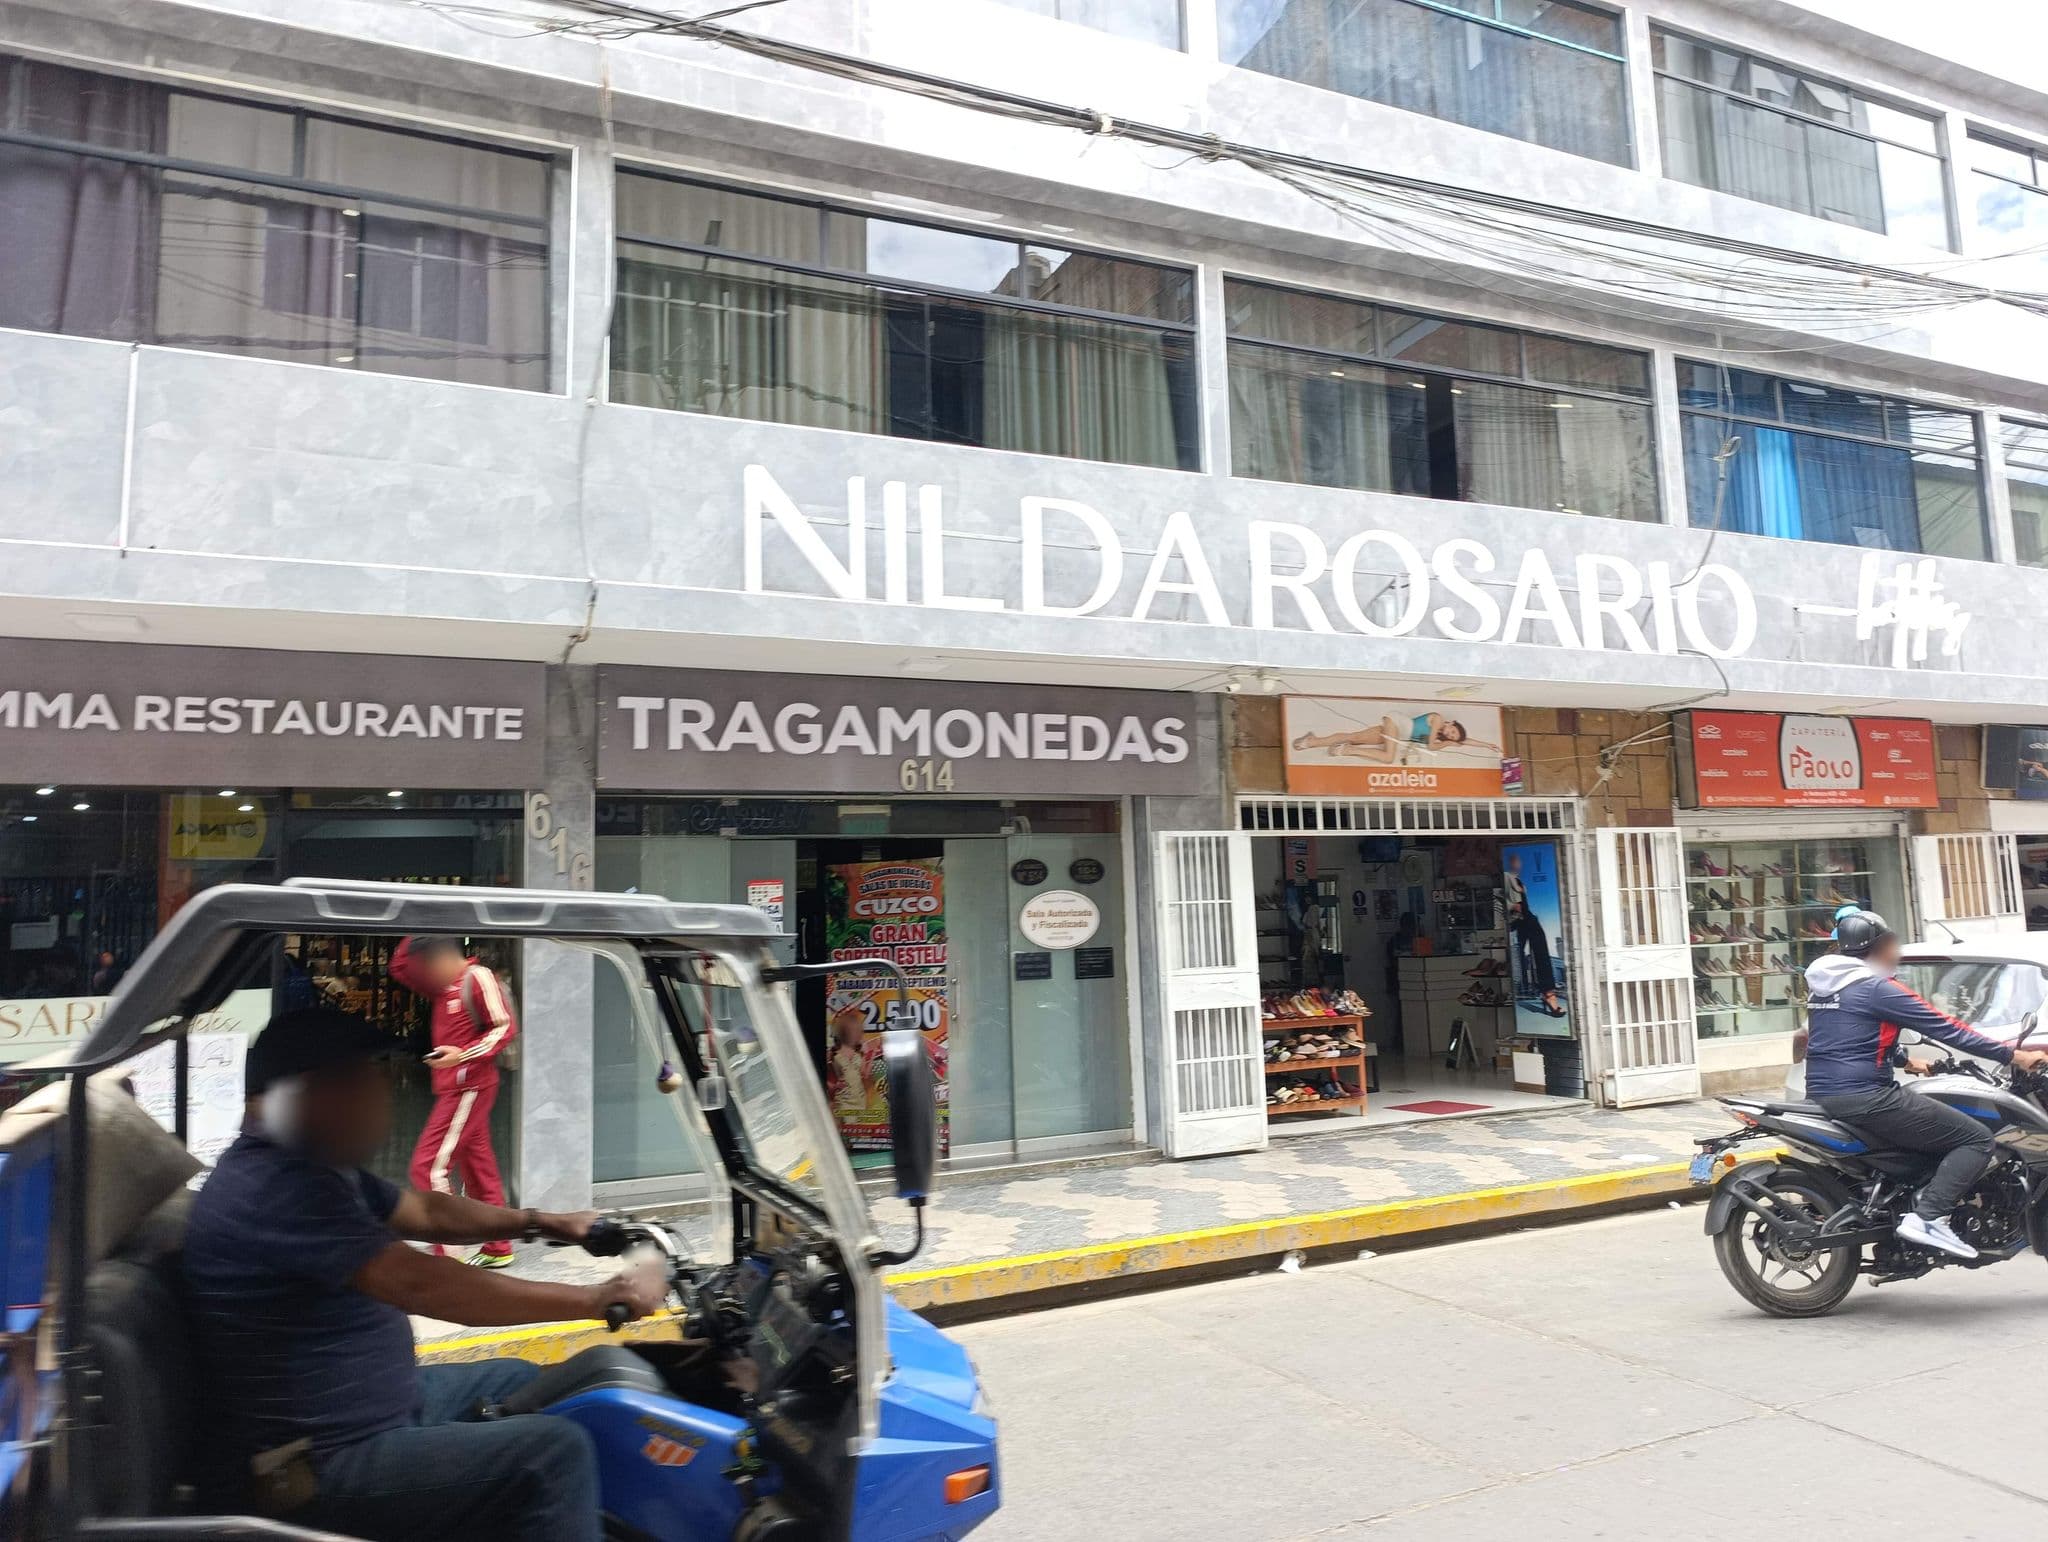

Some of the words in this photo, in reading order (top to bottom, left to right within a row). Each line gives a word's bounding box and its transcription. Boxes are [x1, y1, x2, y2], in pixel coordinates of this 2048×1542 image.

[134, 695, 524, 741] RESTAURANTE
[617, 696, 1189, 763] TRAGAMONEDAS
[899, 759, 954, 792] 614
[1367, 769, 1438, 787] azaleia
[855, 895, 939, 916] CUZCO
[871, 923, 927, 943] GRAN
